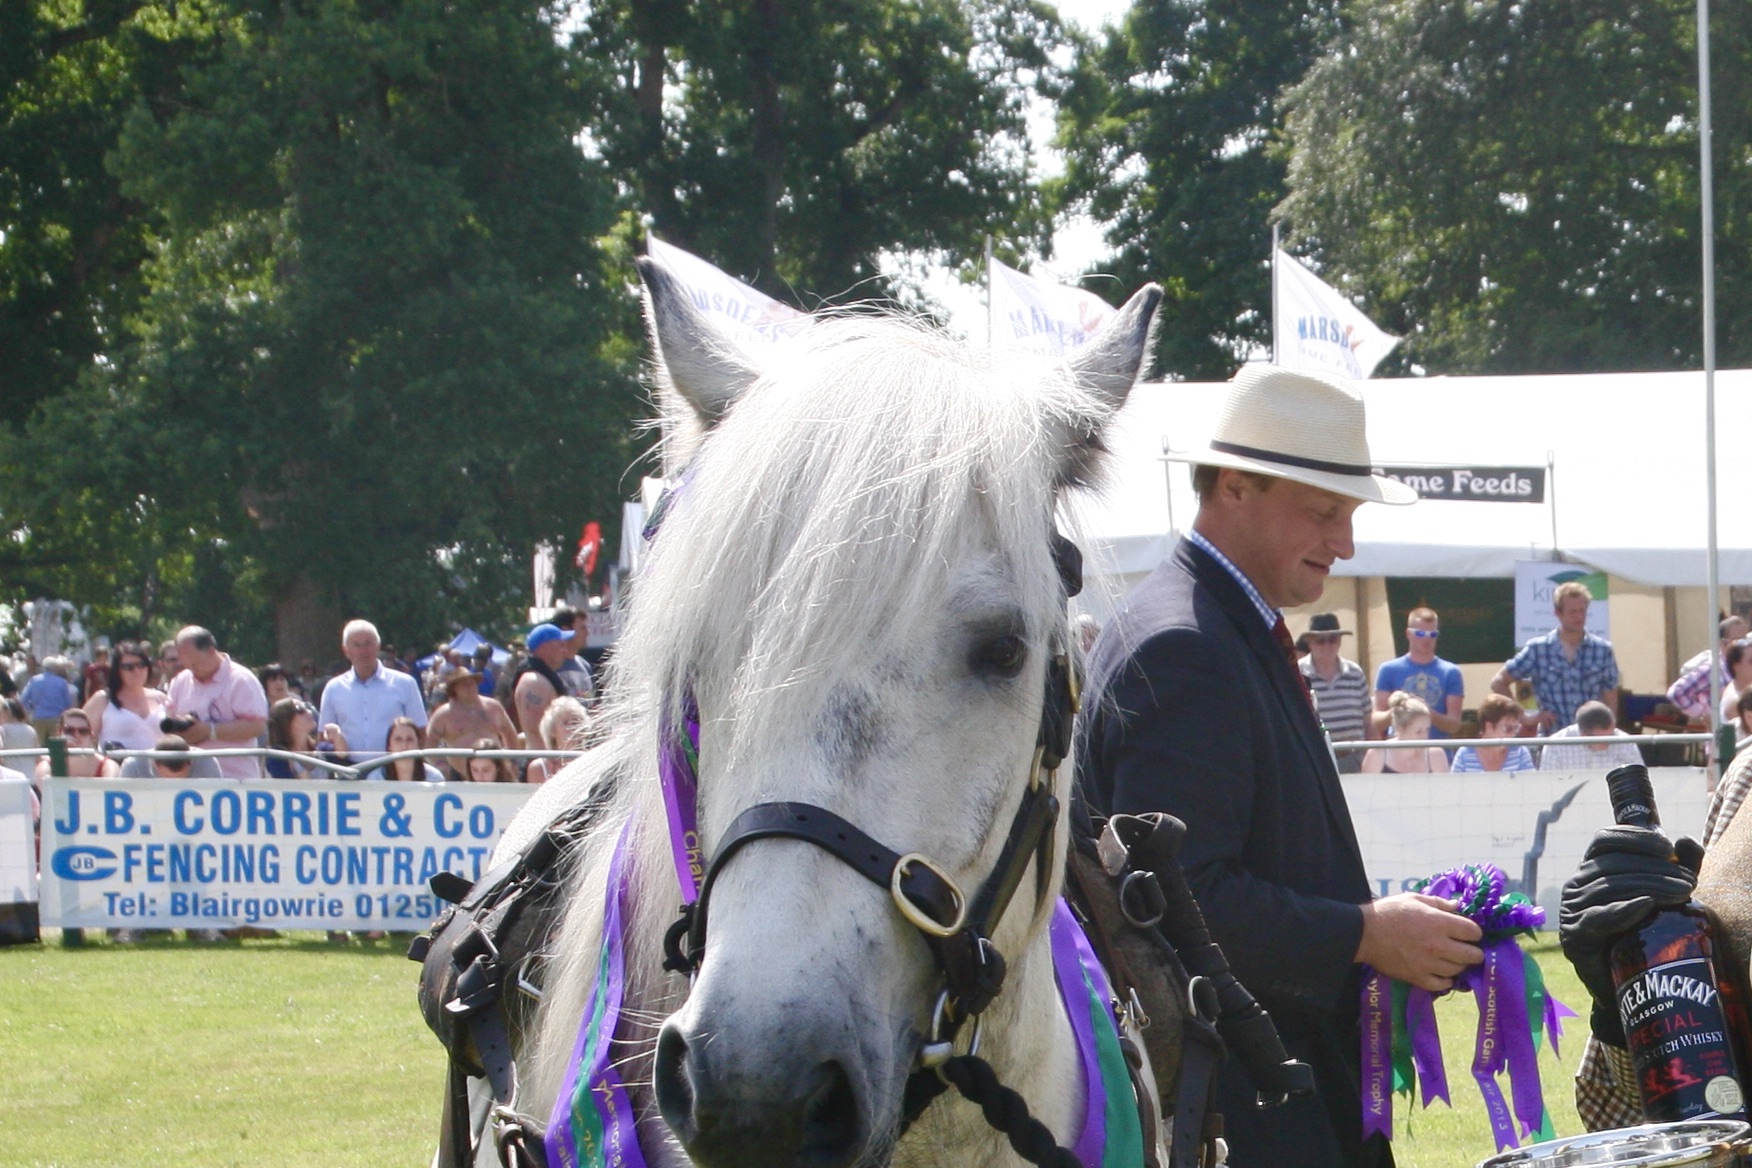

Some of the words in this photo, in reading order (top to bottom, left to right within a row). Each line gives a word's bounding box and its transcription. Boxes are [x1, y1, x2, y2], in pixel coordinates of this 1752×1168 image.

[1452, 469, 1533, 496] Feeds
[54, 791, 152, 836] J.B.
[173, 790, 362, 838] CORRIE
[379, 792, 414, 838] &
[73, 857, 95, 869] JB
[123, 843, 280, 884] FENCING
[295, 843, 492, 886] CONTRACT
[103, 891, 157, 917] Tel:
[171, 891, 344, 923] Blairgowrie
[1645, 970, 1717, 1007] MACKAY
[1629, 1000, 1675, 1027] GLASGOW
[1630, 1010, 1703, 1047] PECIAL
[1369, 1011, 1384, 1068] Memorial
[1679, 1031, 1724, 1047] WHISKY
[1370, 1069, 1386, 1116] Trophy
